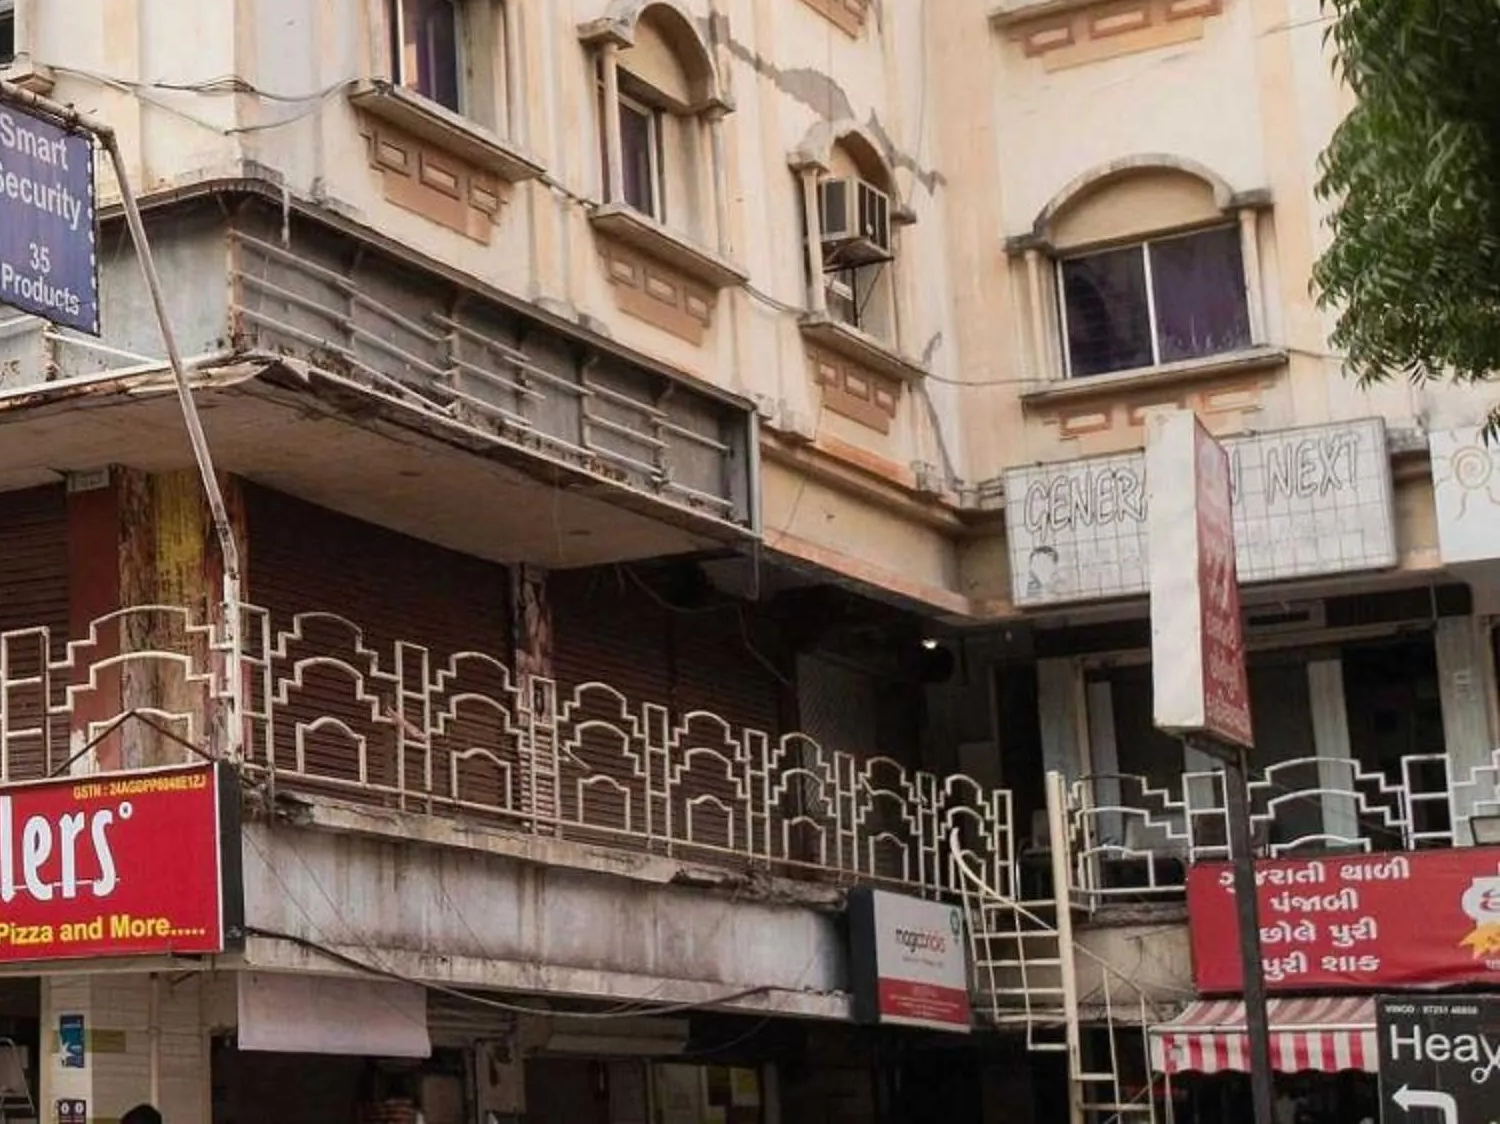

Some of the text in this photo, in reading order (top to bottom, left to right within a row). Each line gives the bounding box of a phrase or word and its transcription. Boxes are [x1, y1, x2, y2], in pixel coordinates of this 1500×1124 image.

[0, 112, 69, 171] Smart
[29, 243, 51, 273] 35
[1, 263, 80, 315] Products
[1266, 432, 1361, 506] NEXT
[1340, 856, 1410, 882] થાળી
[1269, 887, 1359, 914] પંજાબી
[60, 917, 103, 941] and
[1329, 917, 1378, 948] પુરી
